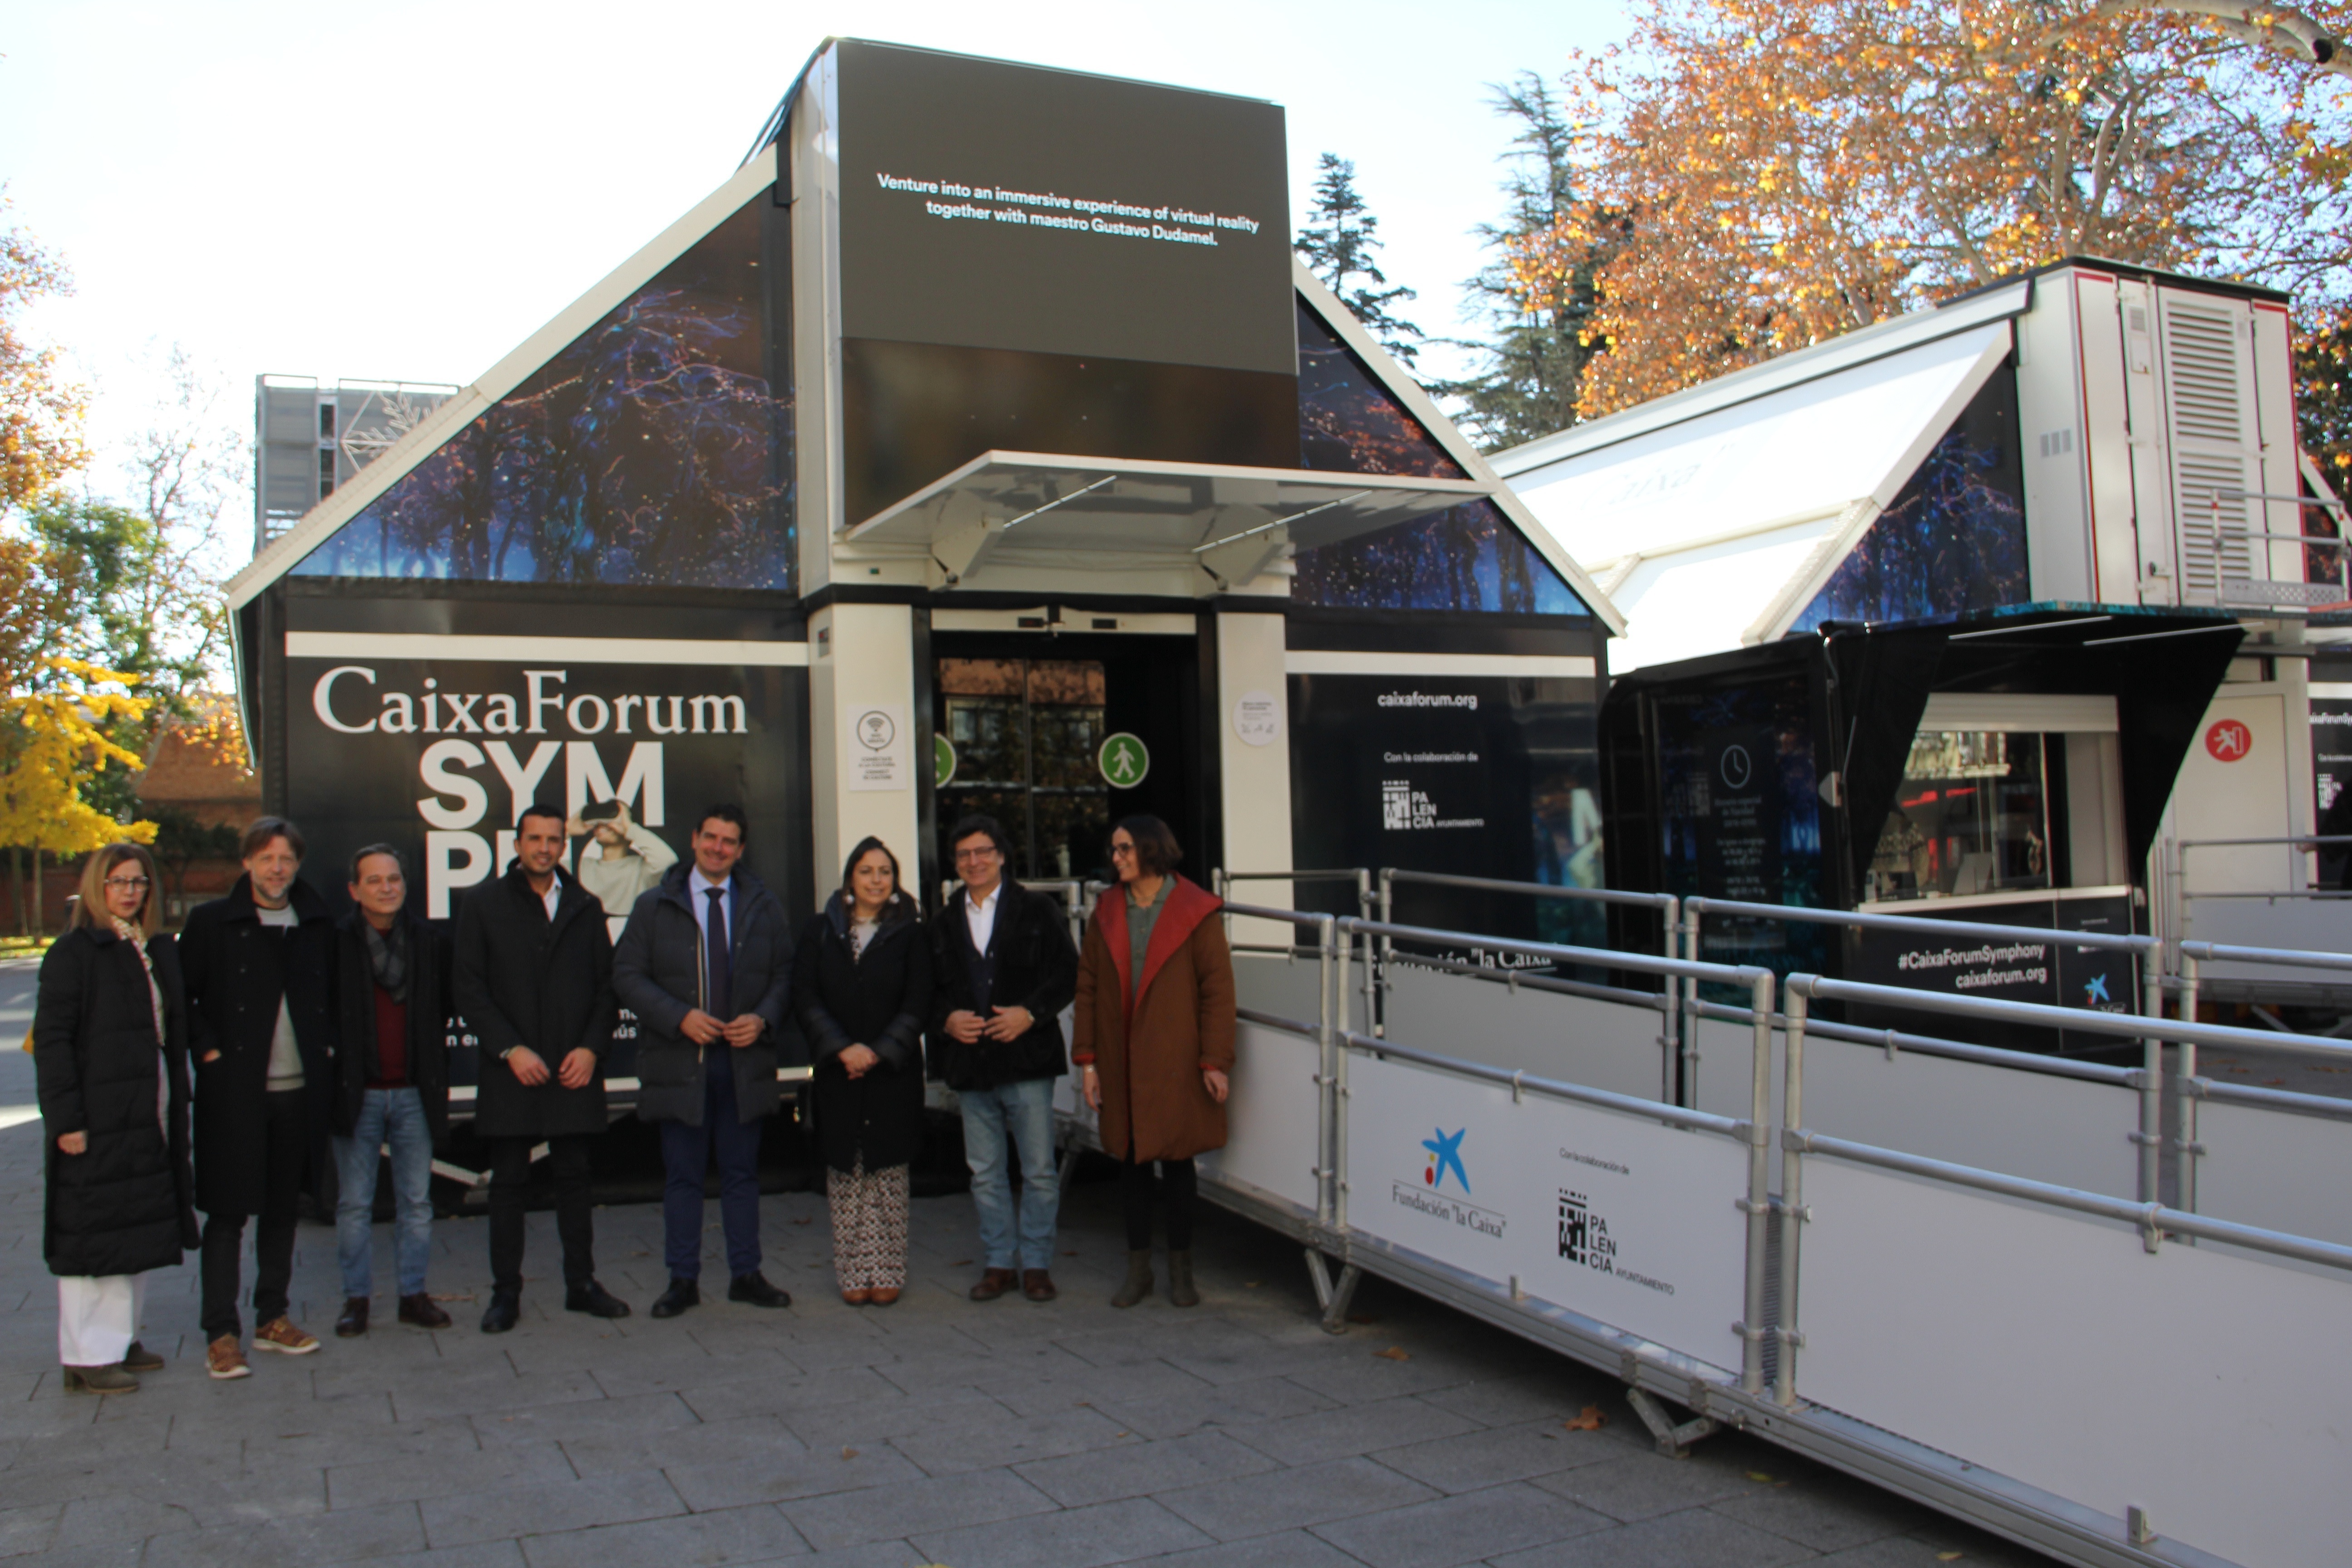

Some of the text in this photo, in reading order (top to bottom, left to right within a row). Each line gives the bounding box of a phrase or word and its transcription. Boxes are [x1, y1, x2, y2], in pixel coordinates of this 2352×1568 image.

[877, 172, 1259, 234] Venture into an immersive experience of virtual reality
[926, 200, 1218, 246] together with maestro Gustavo Dudamel.
[314, 666, 748, 734] CaixaForum
[1377, 691, 1478, 710] caixaforum.org
[1384, 751, 1479, 763] Con la colaboración de
[417, 739, 665, 830] SYM
[1411, 791, 1429, 803] PA
[1412, 803, 1437, 816] LEN
[1412, 816, 1435, 829] CIA
[1898, 942, 2045, 970] #CaixaForumSymphony
[1955, 967, 2048, 989] caixaforum.org
[1559, 1147, 1572, 1159] Con
[1579, 1154, 1619, 1173] colaboración
[1620, 1163, 1631, 1176] de
[1392, 1184, 1450, 1220] Fundación
[1589, 1214, 1607, 1235] PA
[1590, 1233, 1617, 1256] LEN
[1589, 1252, 1675, 1295] CIA AYUNTAMIENTO
